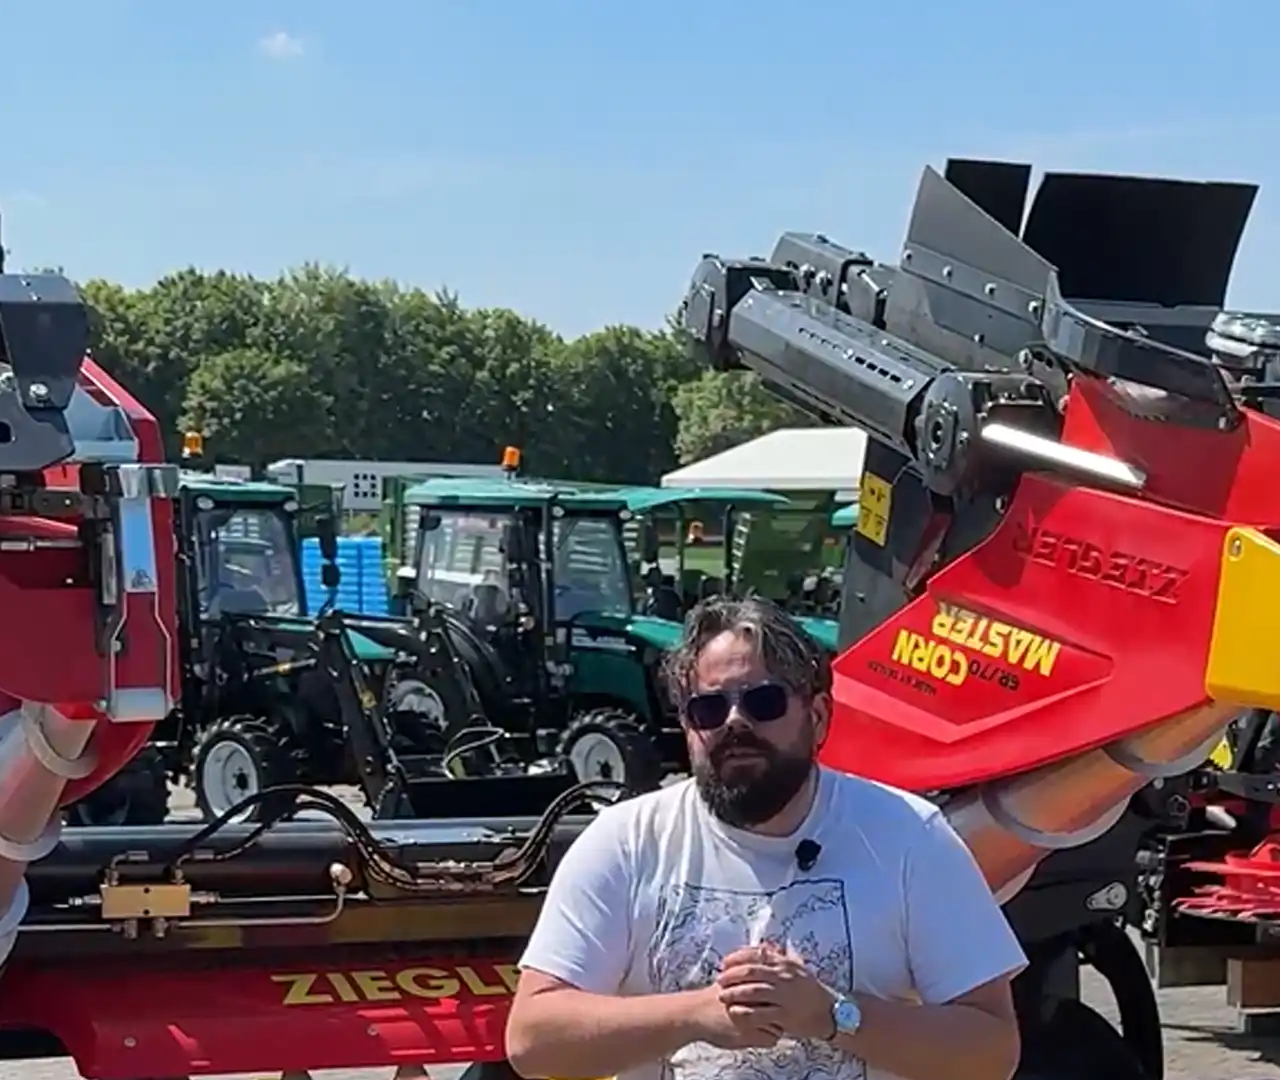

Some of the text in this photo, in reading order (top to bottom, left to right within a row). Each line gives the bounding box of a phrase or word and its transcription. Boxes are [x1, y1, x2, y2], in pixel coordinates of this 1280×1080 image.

[1013, 524, 1190, 604] ZIEGLER
[892, 629, 969, 686] CORN
[933, 602, 1061, 677] MASTER
